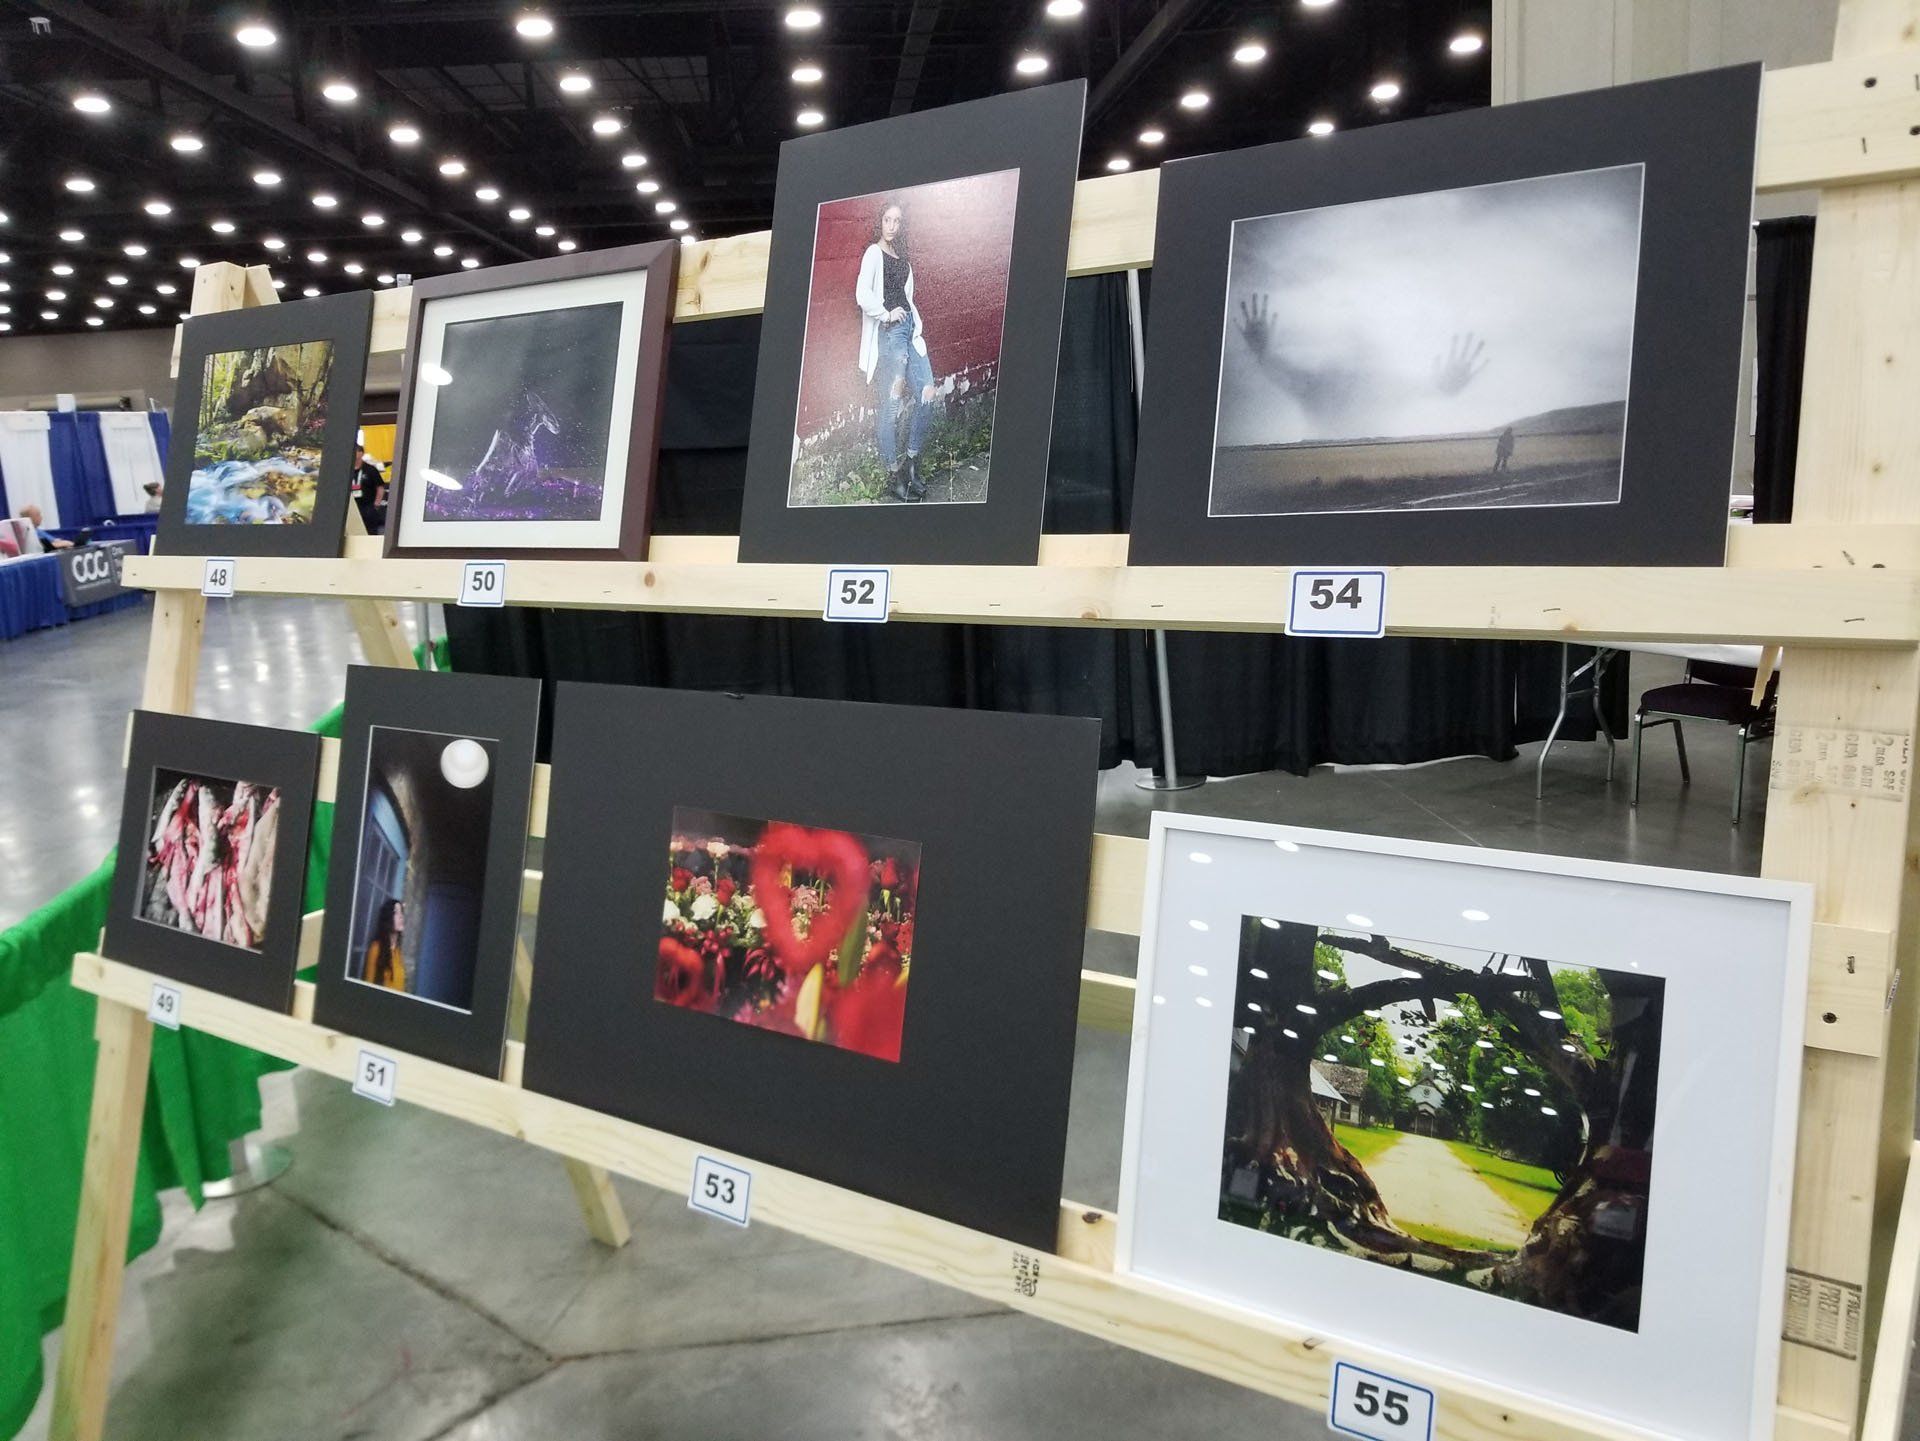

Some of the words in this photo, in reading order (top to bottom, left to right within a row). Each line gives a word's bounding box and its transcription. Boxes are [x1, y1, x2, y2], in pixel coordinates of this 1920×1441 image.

[72, 550, 109, 582] CCC
[209, 568, 227, 586] 48
[472, 570, 495, 591] 50
[840, 579, 876, 605] 52
[1309, 577, 1362, 610] 54
[157, 993, 174, 1013] 49
[365, 1061, 385, 1087] 51
[705, 1172, 735, 1204] 53
[1353, 1381, 1409, 1426] 55
